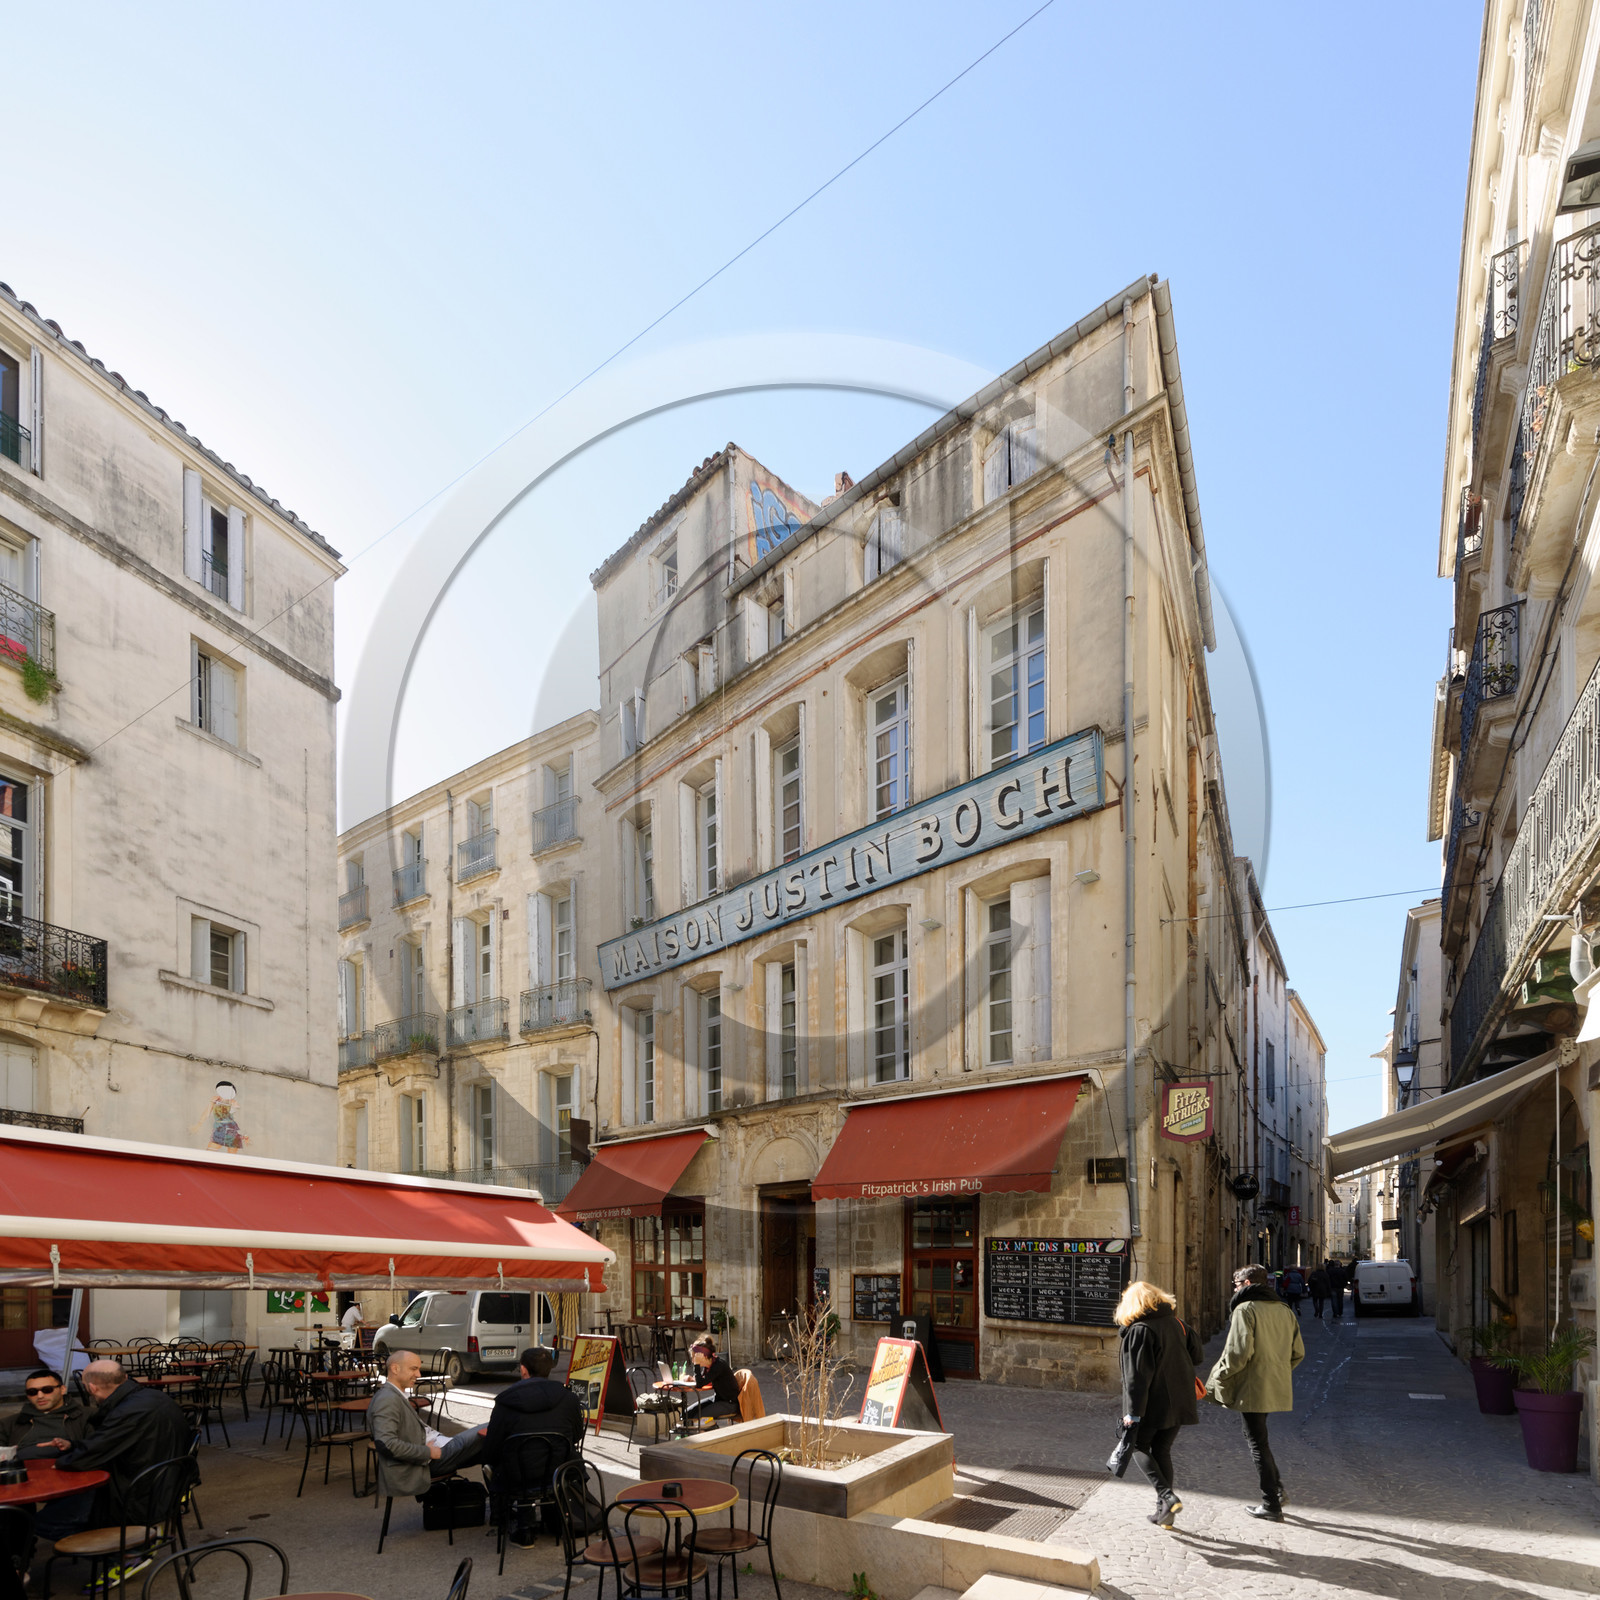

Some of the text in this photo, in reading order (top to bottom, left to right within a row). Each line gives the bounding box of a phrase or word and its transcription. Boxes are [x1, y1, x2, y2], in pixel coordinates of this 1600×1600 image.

[613, 756, 1077, 980] MAISON JUSTIN BOCH
[1163, 1095, 1210, 1128] PATRICK'S
[932, 1179, 956, 1192] Irish
[960, 1178, 983, 1191] Pub
[608, 1208, 620, 1217] Irish
[620, 1207, 632, 1216] Pub
[991, 1240, 1103, 1253] SIX NATIONS RUGBY
[1083, 1291, 1109, 1299] TABLE
